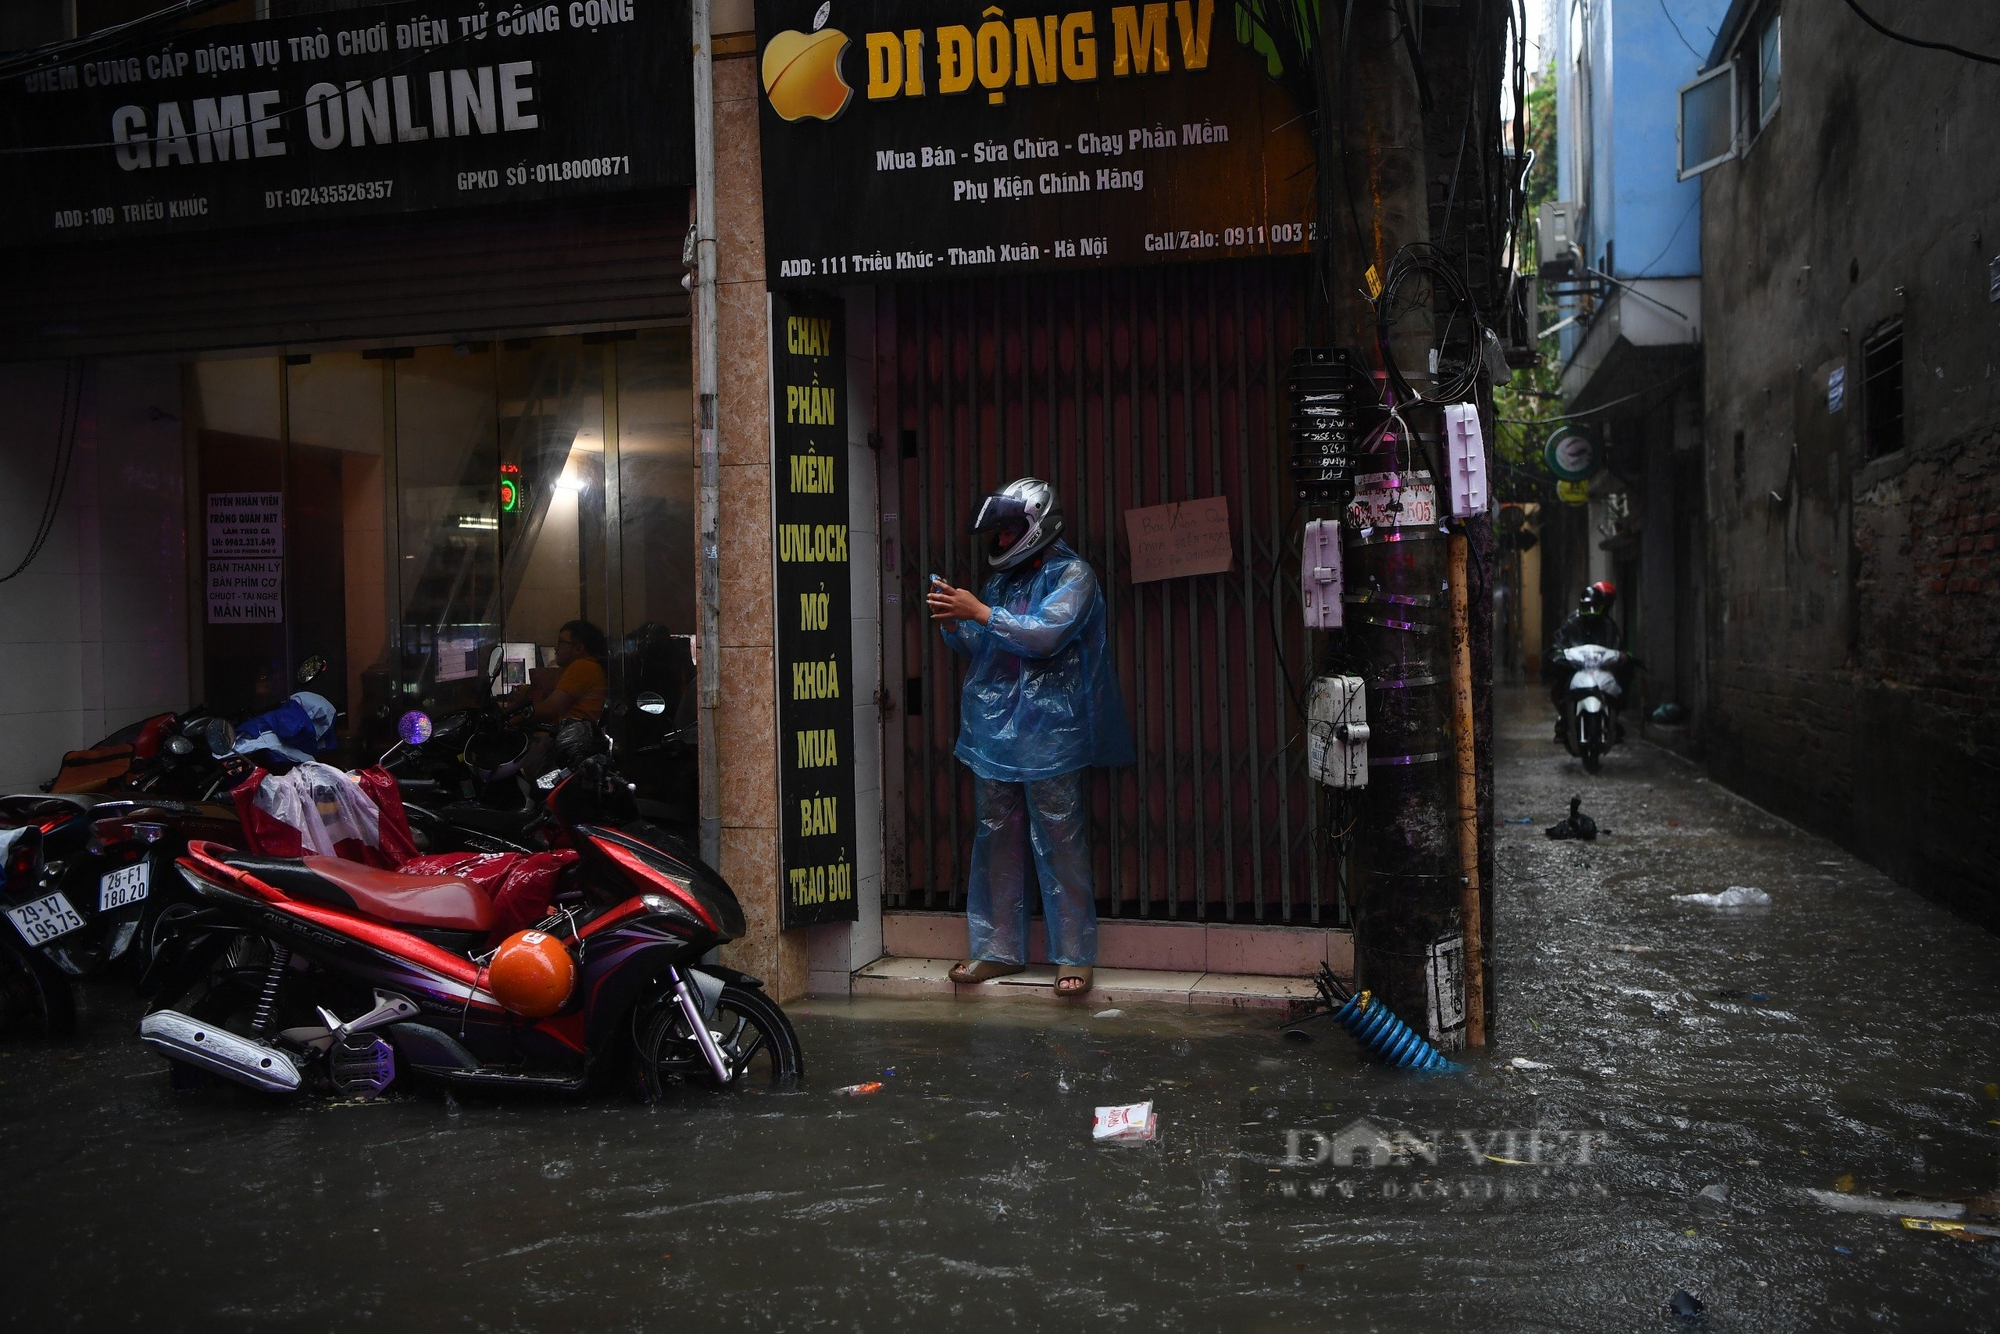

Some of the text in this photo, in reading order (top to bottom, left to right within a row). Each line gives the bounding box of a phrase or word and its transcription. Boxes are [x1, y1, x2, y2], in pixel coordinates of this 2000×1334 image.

[83, 57, 141, 87] CUNG
[147, 42, 189, 80] CẤP
[195, 42, 245, 79] DỊCH
[251, 40, 281, 72] VỤ
[288, 27, 330, 62] TRÒ
[337, 22, 389, 57] CHƠI
[396, 15, 449, 54] ĐIỆN
[496, 4, 560, 37] CÔNG
[865, 0, 1216, 106] DI ĐỘNG MV
[111, 60, 540, 172] GAME ONLINE
[876, 149, 917, 172] Mua
[921, 145, 956, 168] Bán
[974, 140, 1008, 164] Sửa
[1013, 137, 1060, 160] Chữa
[1077, 132, 1124, 157] Chạy
[1128, 122, 1177, 150] Phần
[1182, 118, 1230, 146] Mềm
[265, 180, 394, 210] ĐT:02435526357
[457, 169, 499, 192] GPKD
[953, 167, 1144, 203] Phụ Kiện Chính Hãng
[122, 195, 164, 224] TRIỀU
[169, 193, 209, 219] KHÚC
[780, 259, 816, 278] ADD:
[821, 256, 848, 275] 111
[852, 250, 892, 272] Triều
[896, 249, 934, 270] Khúc
[948, 245, 995, 266] Thanh
[1000, 242, 1039, 262] Xuân
[1054, 238, 1076, 260] Hà
[1080, 236, 1108, 260] Nội
[1144, 228, 1219, 252] Call/Zalo:
[1224, 225, 1265, 247] 0911
[1271, 222, 1303, 243] 003
[787, 315, 831, 364] CHẠY
[787, 370, 835, 426] PHẦN
[790, 439, 835, 494] MỀM
[212, 538, 223, 547] LH:
[779, 523, 848, 563] UNLOCK
[210, 561, 280, 573] BÁN THANH LÝ
[213, 603, 276, 618] MÀN HÌNH
[243, 592, 254, 600] TAI
[256, 592, 278, 600] NGHE
[800, 581, 830, 631] MỞ
[792, 653, 840, 701] KHOÁ
[797, 728, 838, 769] MUA
[800, 790, 838, 837] BÁN
[104, 882, 145, 909] 180.20
[790, 847, 852, 906] TRAO ĐỔI
[17, 896, 62, 926] 29-X7
[26, 910, 81, 942] 195.75
